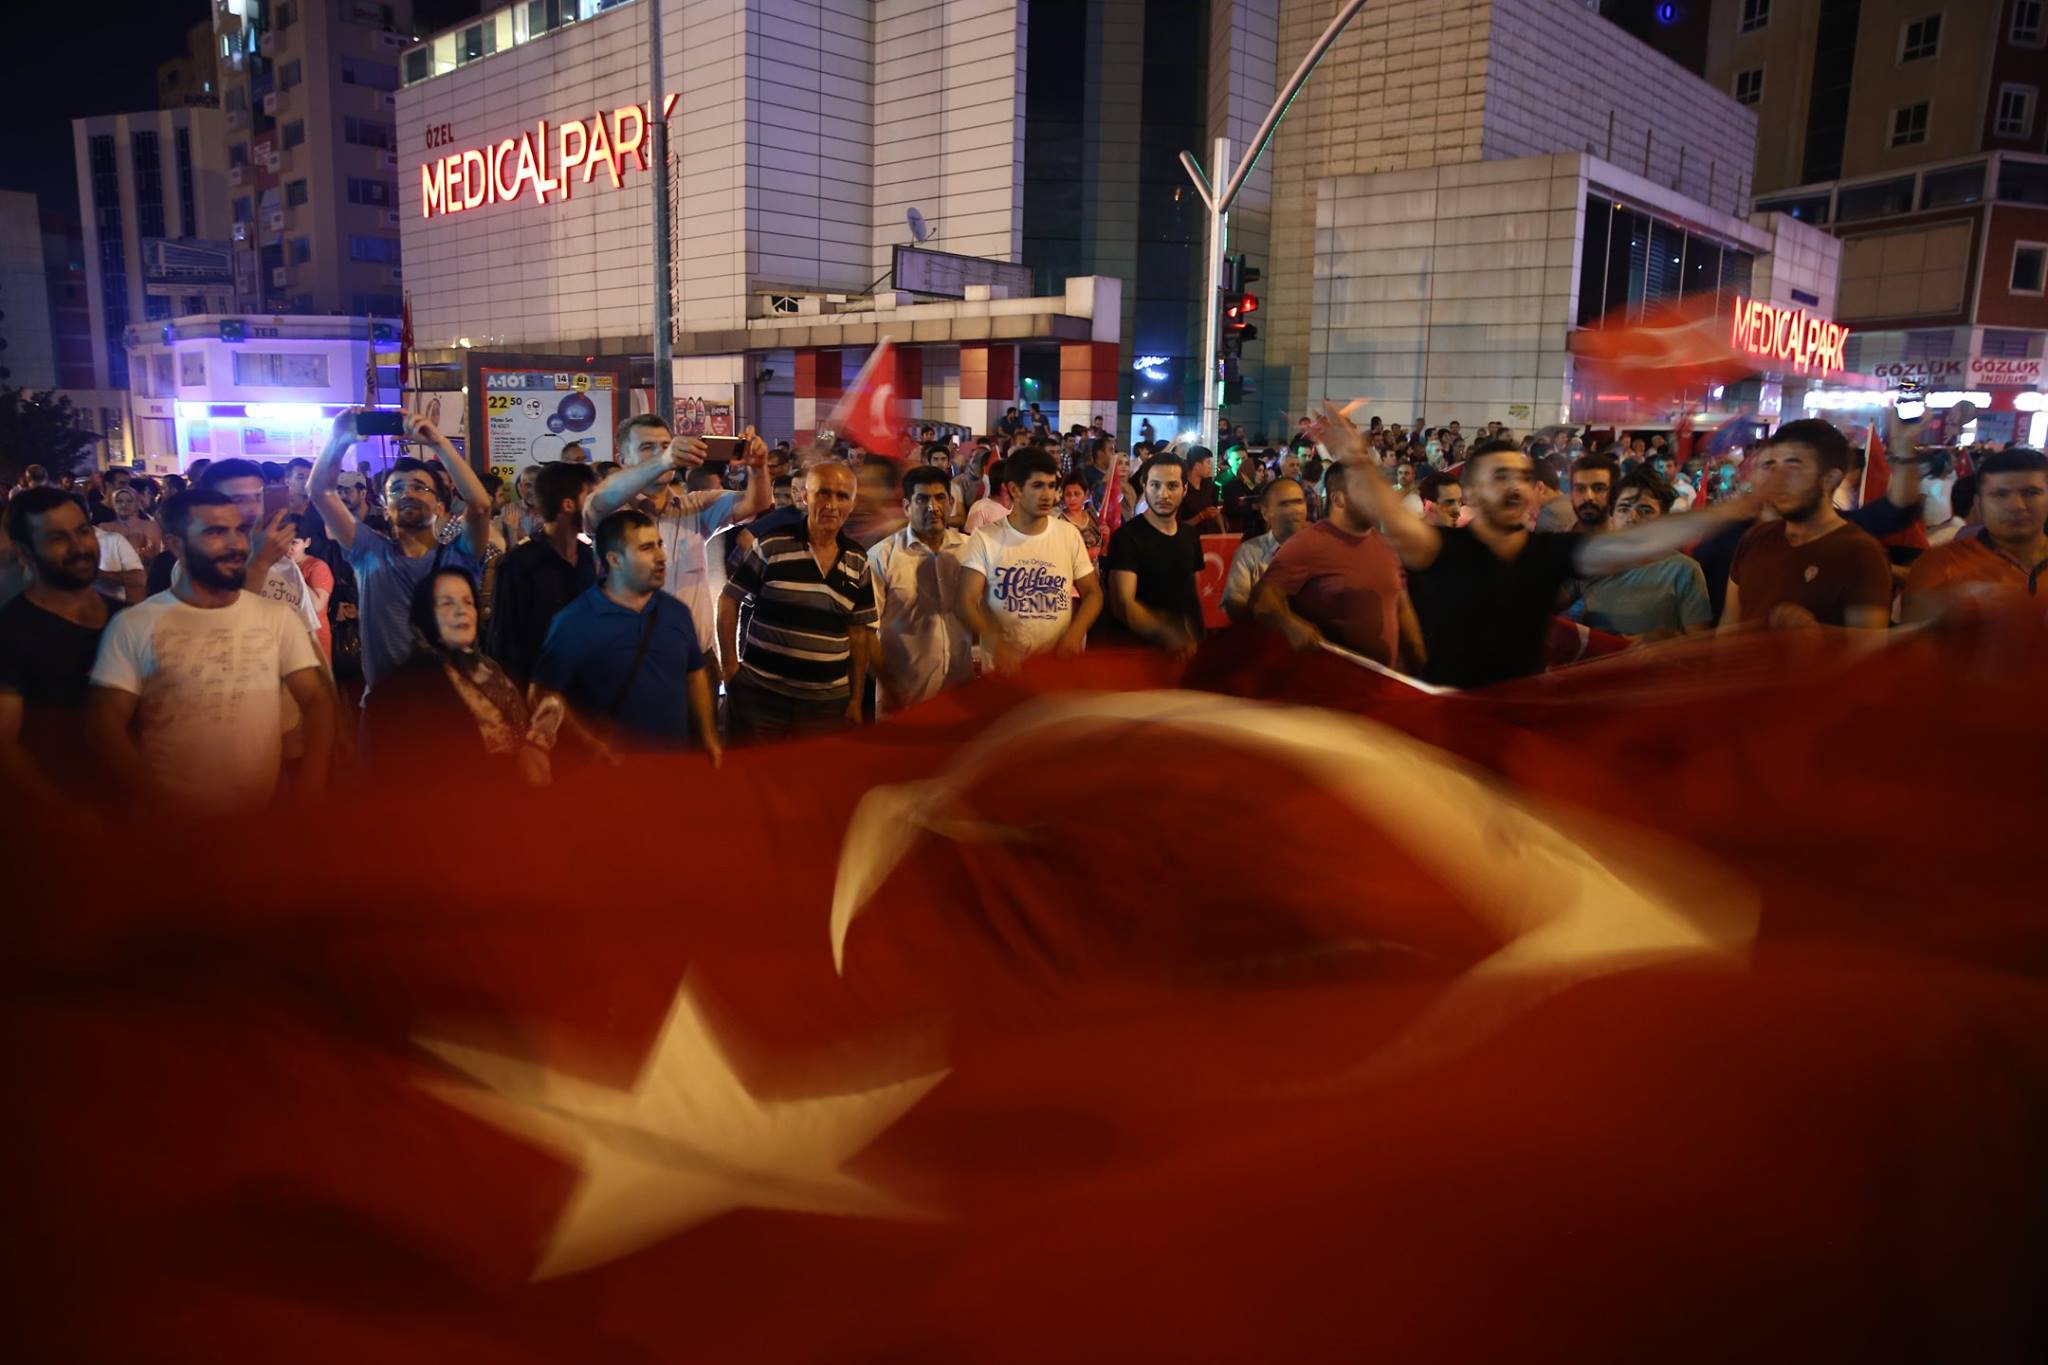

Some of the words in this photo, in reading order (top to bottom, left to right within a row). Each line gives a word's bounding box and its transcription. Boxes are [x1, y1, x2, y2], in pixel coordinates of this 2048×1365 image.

[425, 122, 455, 149] ÖZEL
[488, 396, 508, 409] 22
[510, 397, 523, 406] 50
[502, 466, 514, 476] 95
[994, 566, 1067, 600] Hilfiger
[1008, 592, 1058, 613] DENIM
